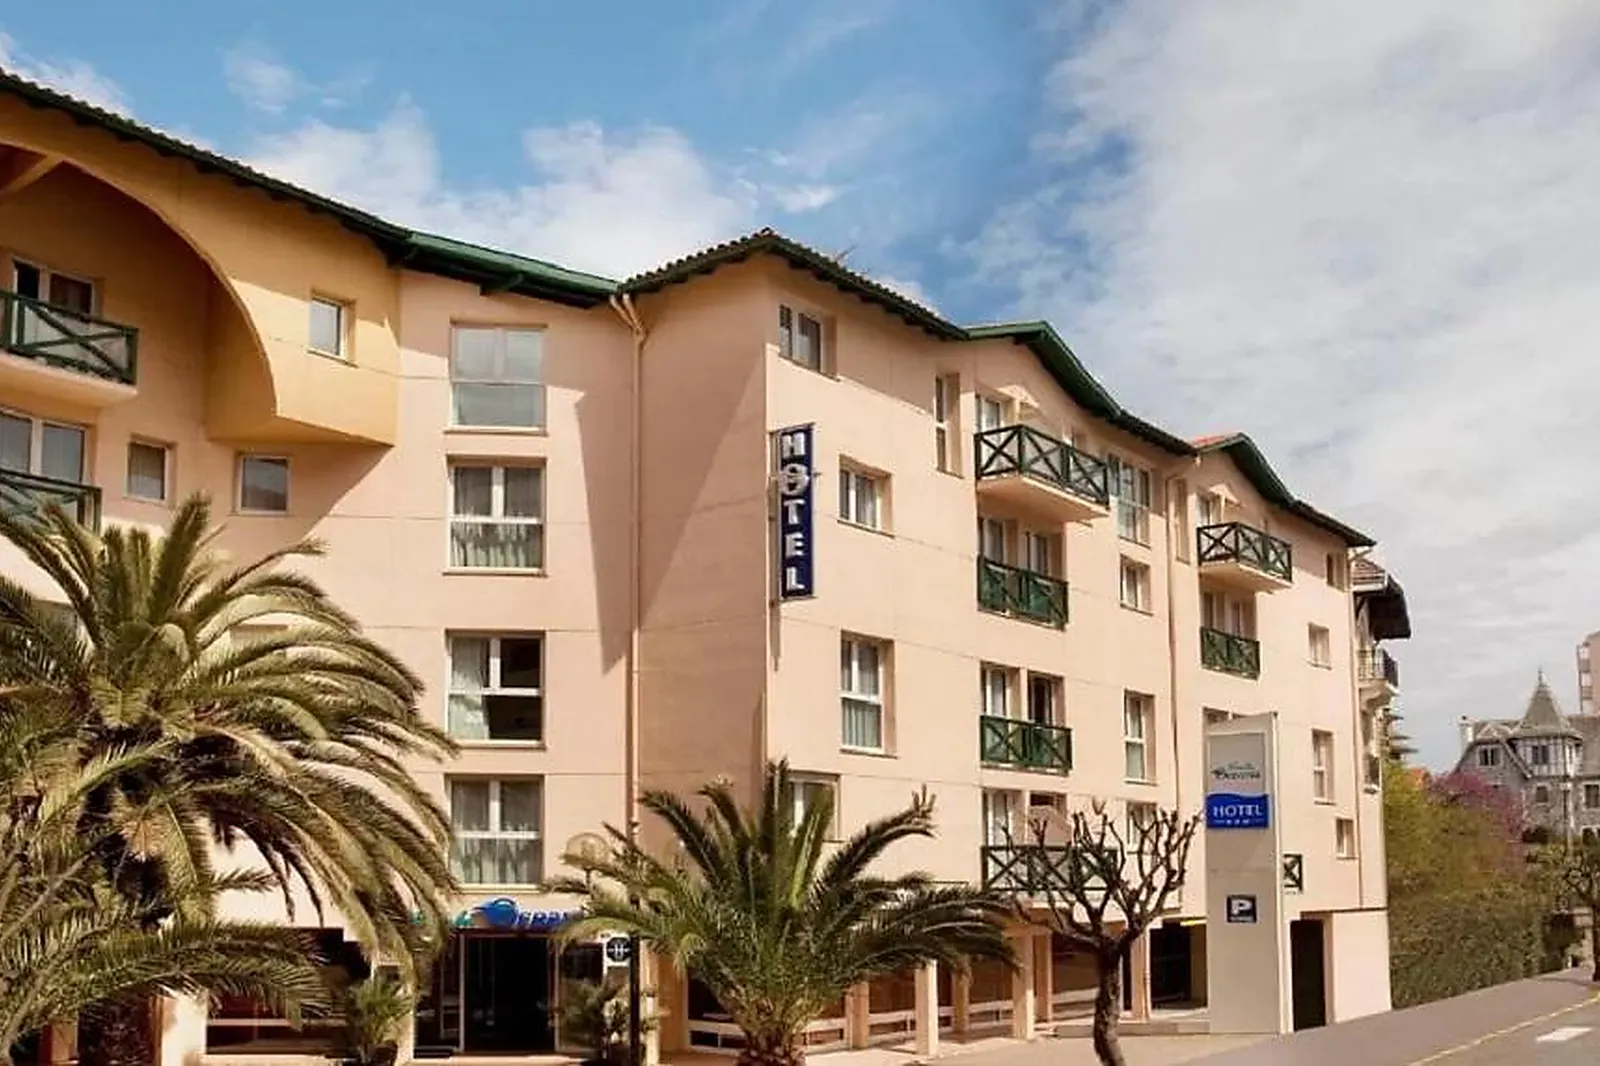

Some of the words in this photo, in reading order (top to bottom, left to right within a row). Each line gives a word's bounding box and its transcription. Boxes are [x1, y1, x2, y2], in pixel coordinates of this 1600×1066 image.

[780, 431, 810, 592] HOTEL
[1213, 804, 1264, 818] HOTEL
[1231, 899, 1252, 915] P
